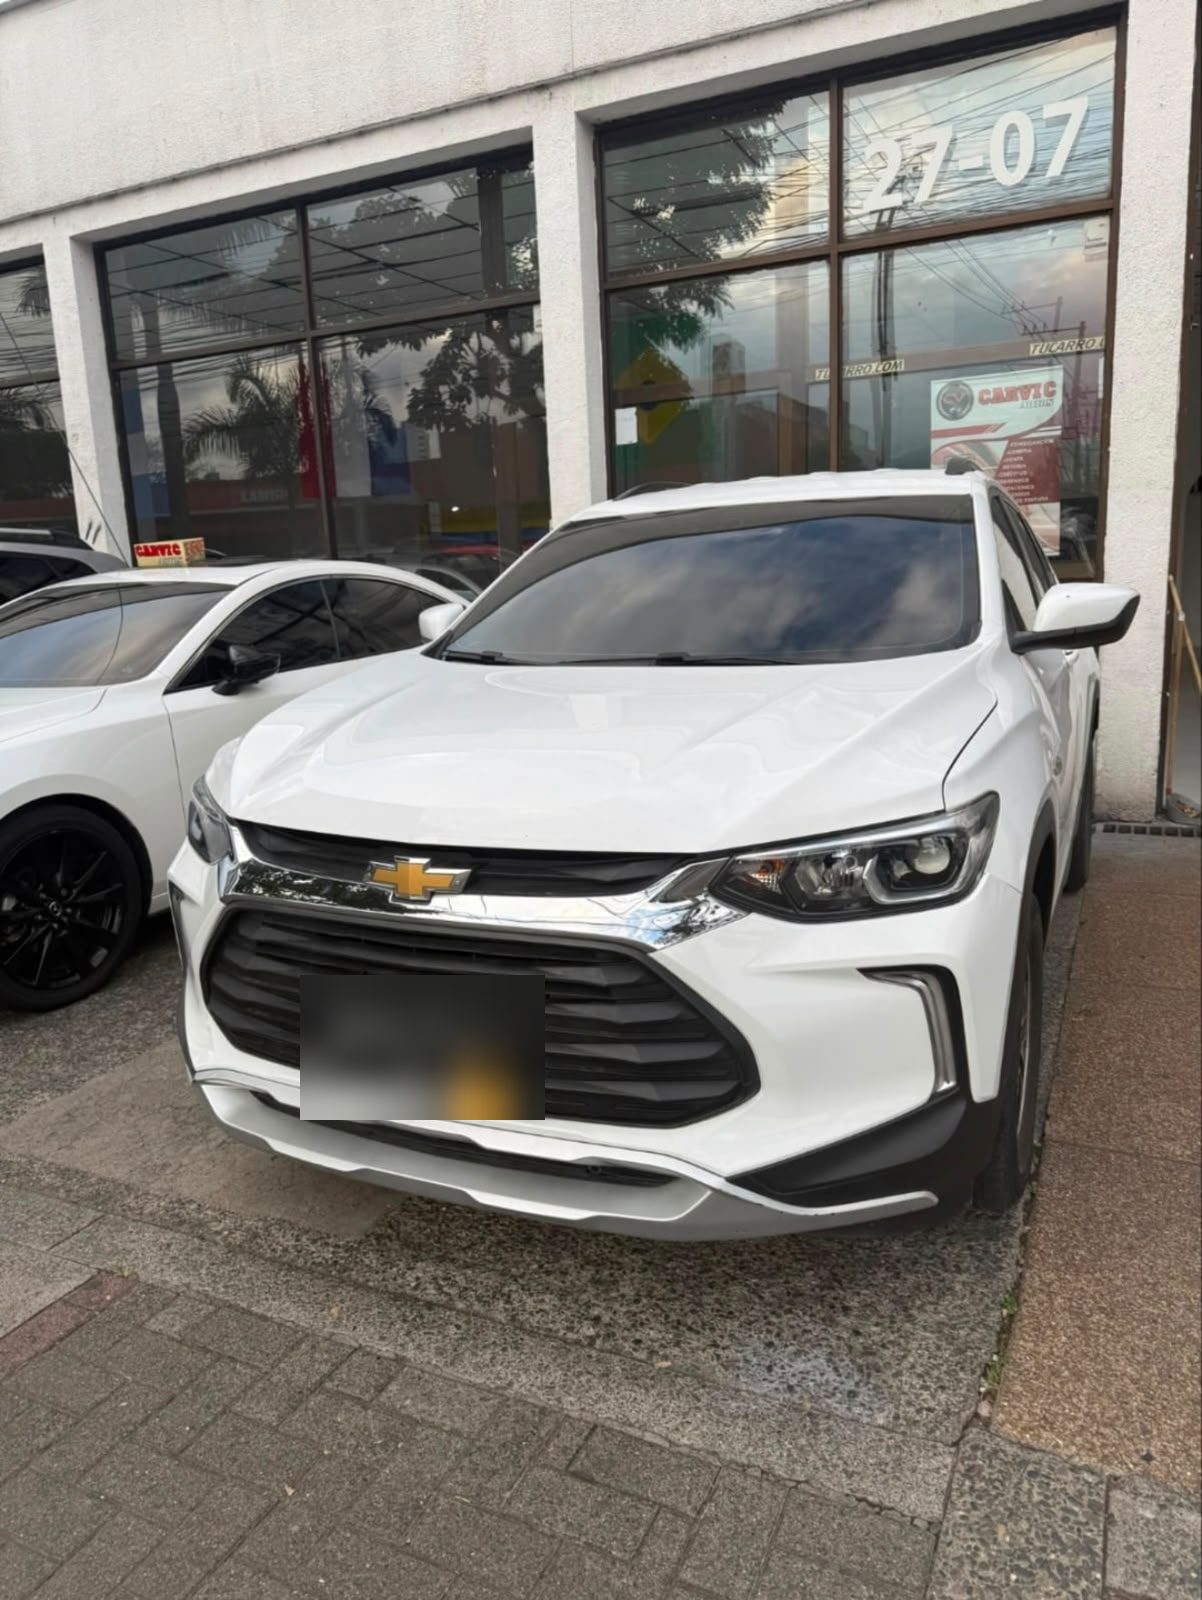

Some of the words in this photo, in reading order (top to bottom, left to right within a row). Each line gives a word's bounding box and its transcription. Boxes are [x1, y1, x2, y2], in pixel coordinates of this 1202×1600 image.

[863, 95, 1089, 214] 27-07
[978, 380, 1057, 405] CARVIC
[135, 543, 182, 557] CARVIC
